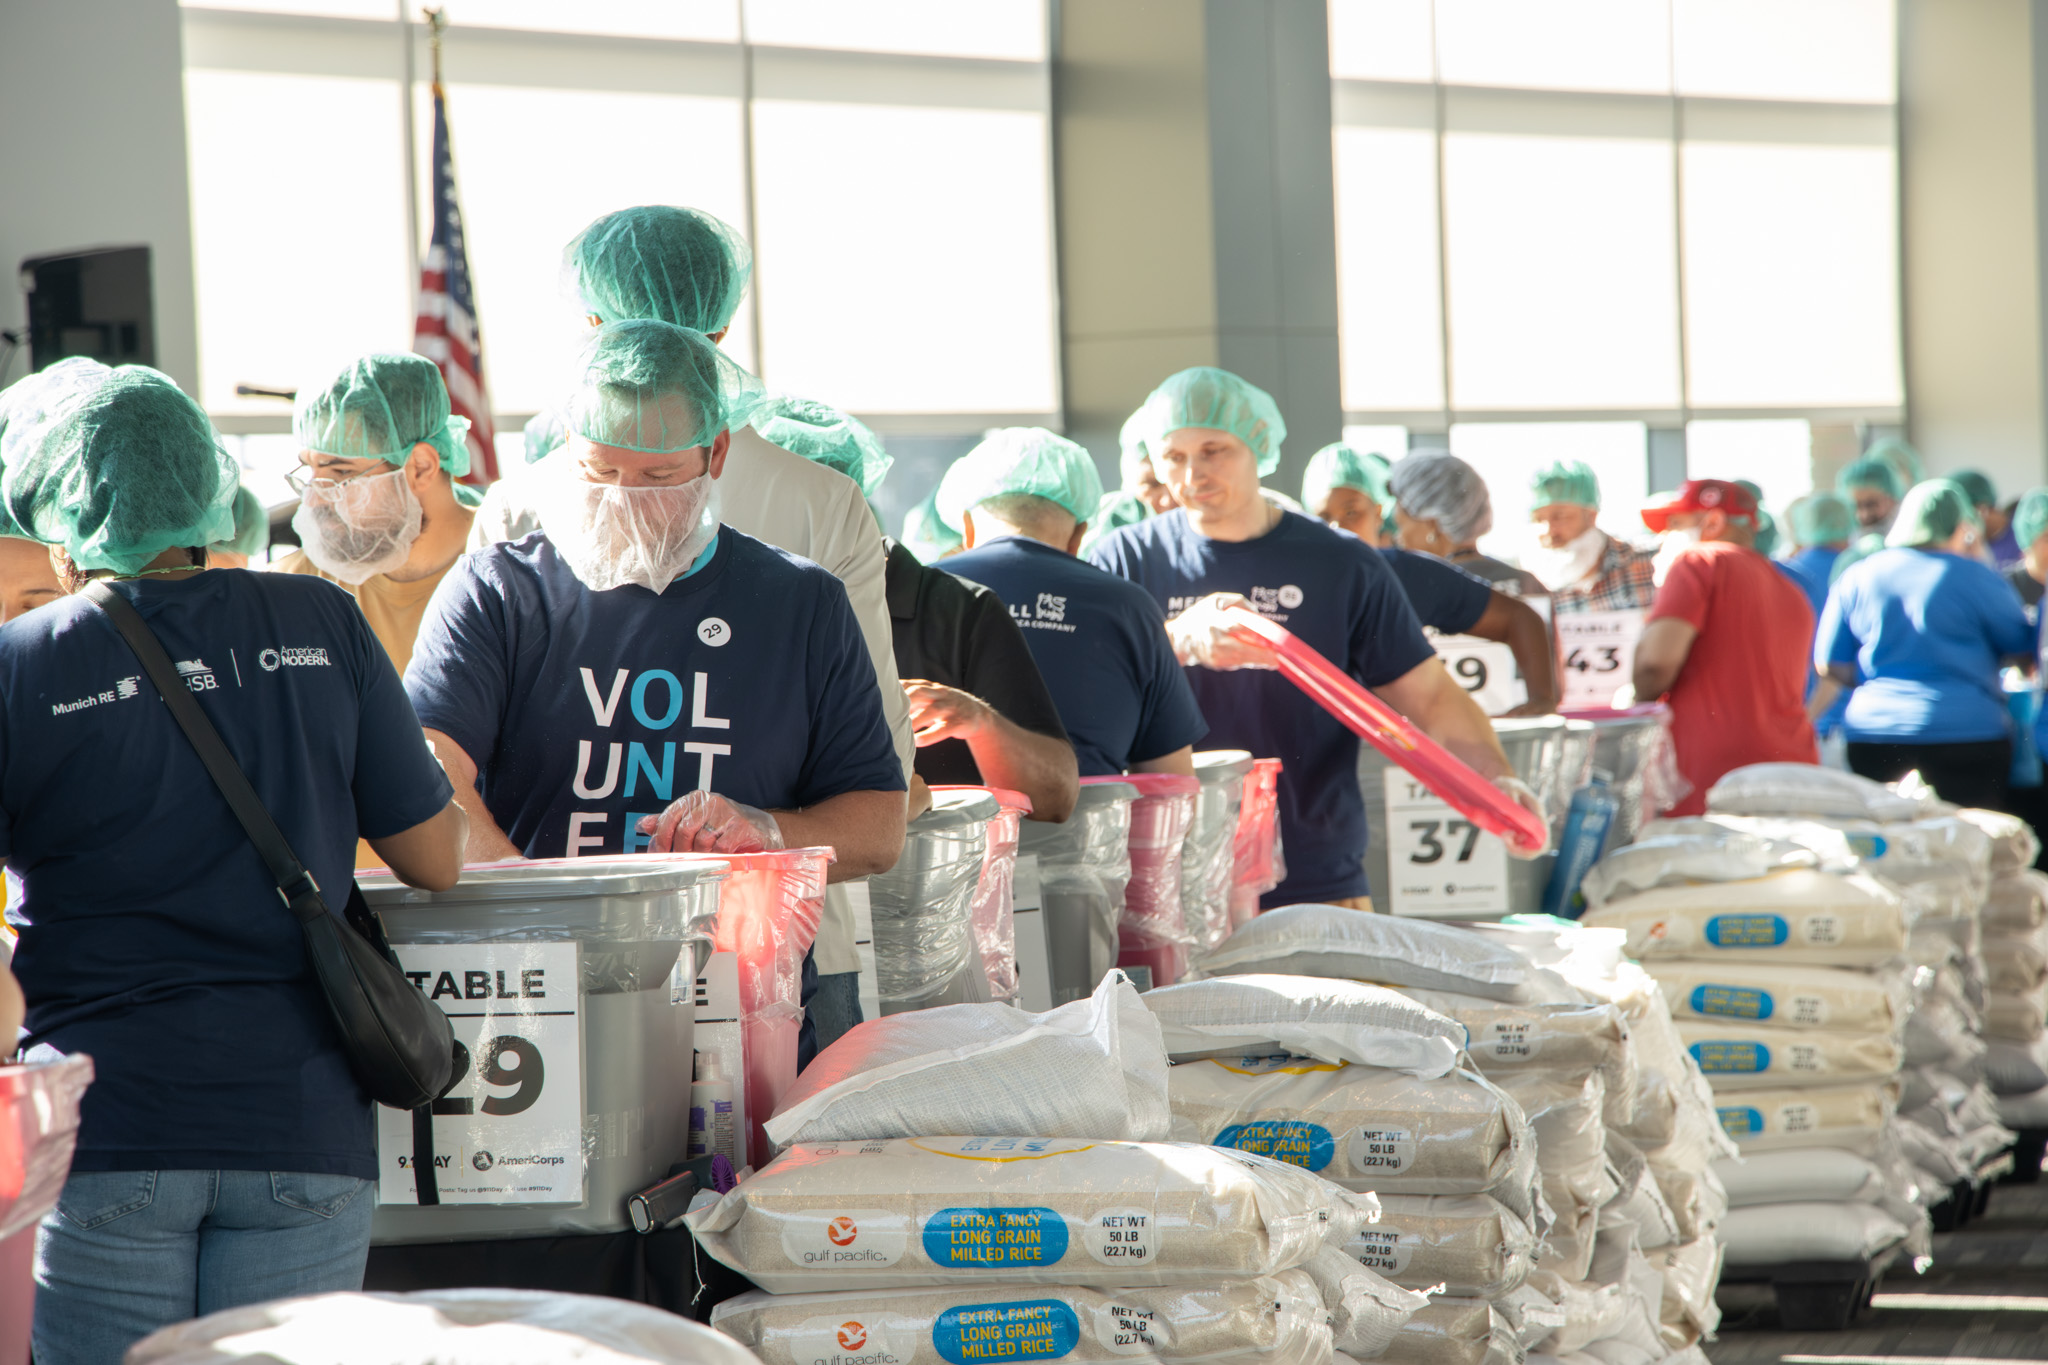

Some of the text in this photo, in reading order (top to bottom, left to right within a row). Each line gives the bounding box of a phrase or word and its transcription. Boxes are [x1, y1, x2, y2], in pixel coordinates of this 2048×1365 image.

[703, 623, 722, 639] 29
[281, 645, 328, 656] American
[1566, 648, 1619, 673] 43
[1450, 656, 1488, 692] 9
[52, 690, 116, 716] Munich RE
[579, 667, 731, 730] VOL
[572, 740, 731, 800] UNT
[1409, 819, 1482, 864] 37
[405, 969, 546, 1000] TABLE
[1236, 1127, 1312, 1140] EXTRA FANCY
[1363, 1131, 1402, 1142] NET WT
[1234, 1140, 1310, 1153] LONG GRAIN
[1369, 1143, 1395, 1154] 50 LB
[434, 1155, 452, 1169] AY
[498, 1155, 565, 1166] AmeriCorps
[1283, 1154, 1310, 1168] RICE
[1363, 1156, 1402, 1169] (22.7 kg)
[950, 1214, 1042, 1228] EXTRA FANCY
[1103, 1216, 1147, 1228] NET WT
[950, 1230, 1042, 1244] LONG GRAIN
[1109, 1231, 1139, 1242] 50 LB
[1361, 1231, 1399, 1242] NET WT
[804, 1249, 831, 1264] gulf
[950, 1247, 1043, 1262] MILLED RICE
[1103, 1244, 1147, 1259] (22.7 kg)
[1366, 1245, 1392, 1255] 50 LB
[1360, 1256, 1397, 1270] (22.7 kg)
[959, 1306, 1051, 1325] EXTRA FANCY
[1111, 1306, 1154, 1320] NET WT
[1119, 1319, 1147, 1331] 50 LB
[960, 1323, 1053, 1342] LONG GRAIN
[1114, 1332, 1138, 1346] (22.7
[962, 1339, 1054, 1359] MILLED RICE
